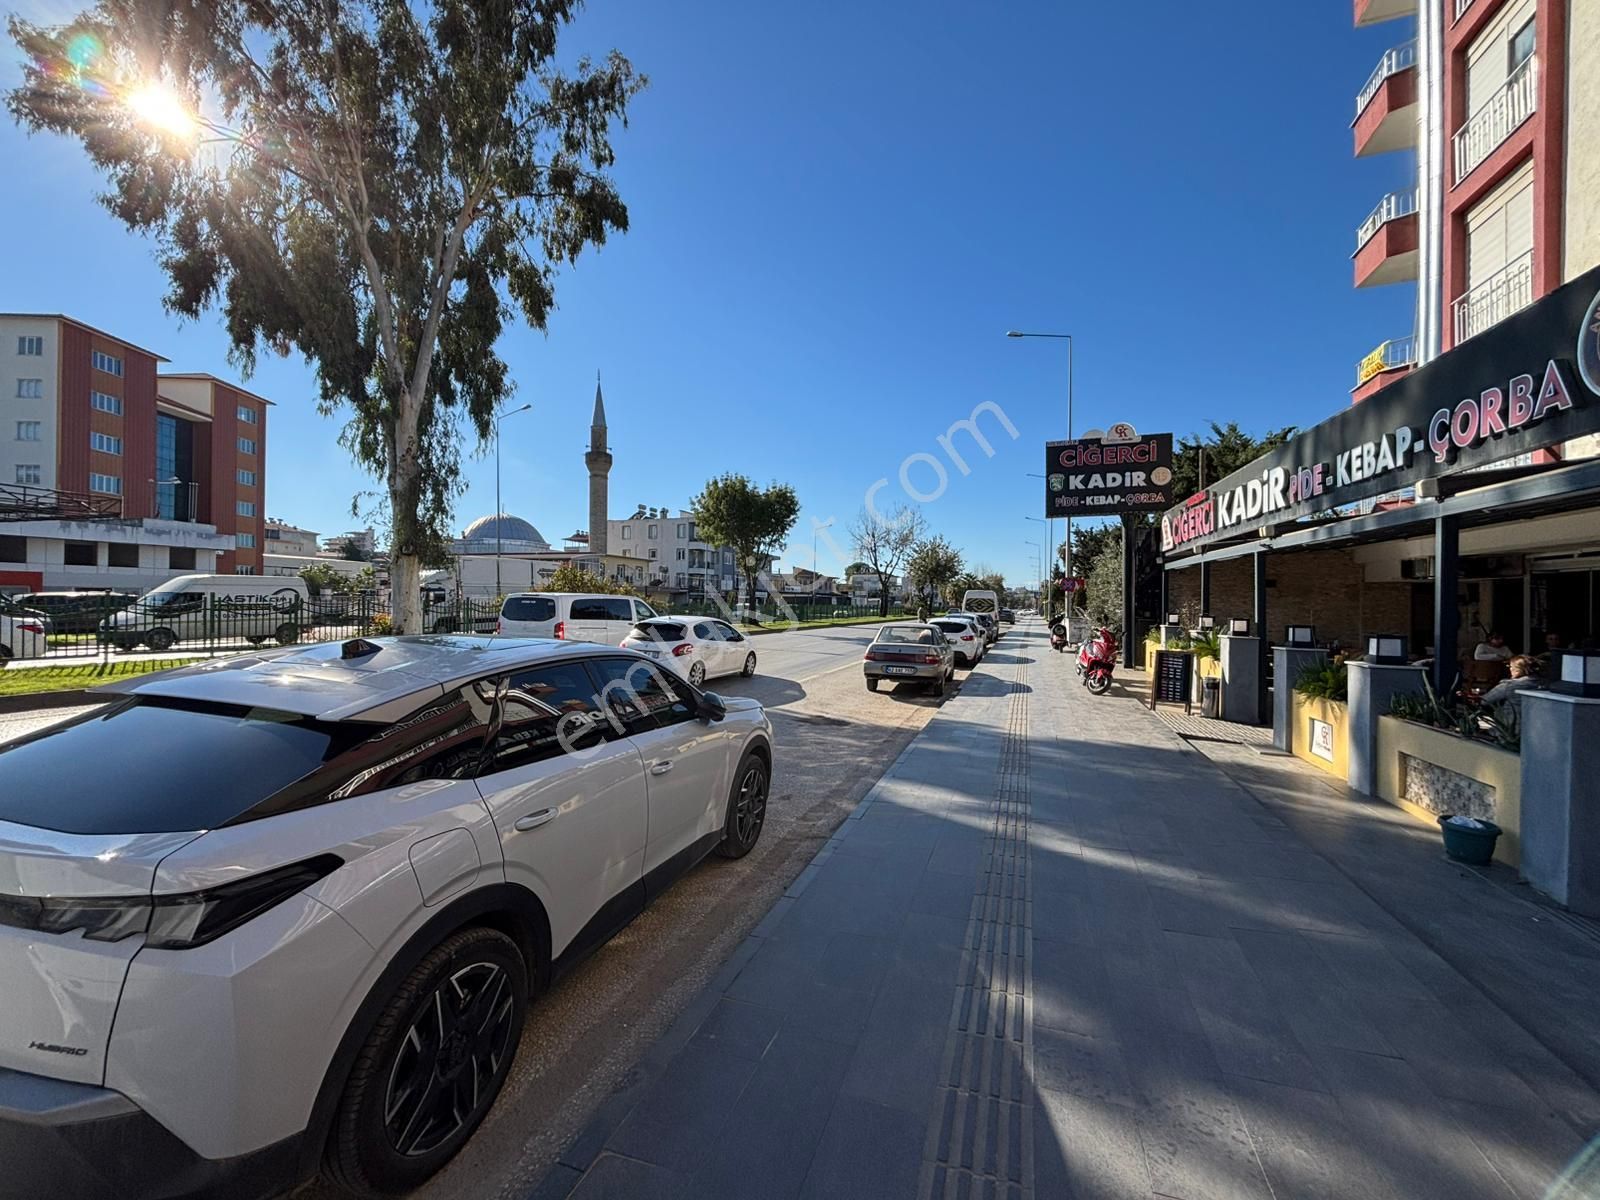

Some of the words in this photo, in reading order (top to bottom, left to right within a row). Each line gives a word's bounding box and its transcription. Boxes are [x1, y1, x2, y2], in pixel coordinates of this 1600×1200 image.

[1288, 462, 1324, 504] PİDE
[1336, 426, 1412, 488] KEBAP
[1428, 359, 1572, 463] ÇORBA
[1059, 440, 1158, 467] CİĞERCİ
[1055, 495, 1079, 507] PİDE
[1086, 494, 1120, 505] KEBAP
[1126, 492, 1165, 506] ÇORBA
[28, 1041, 89, 1056] HYBRID
